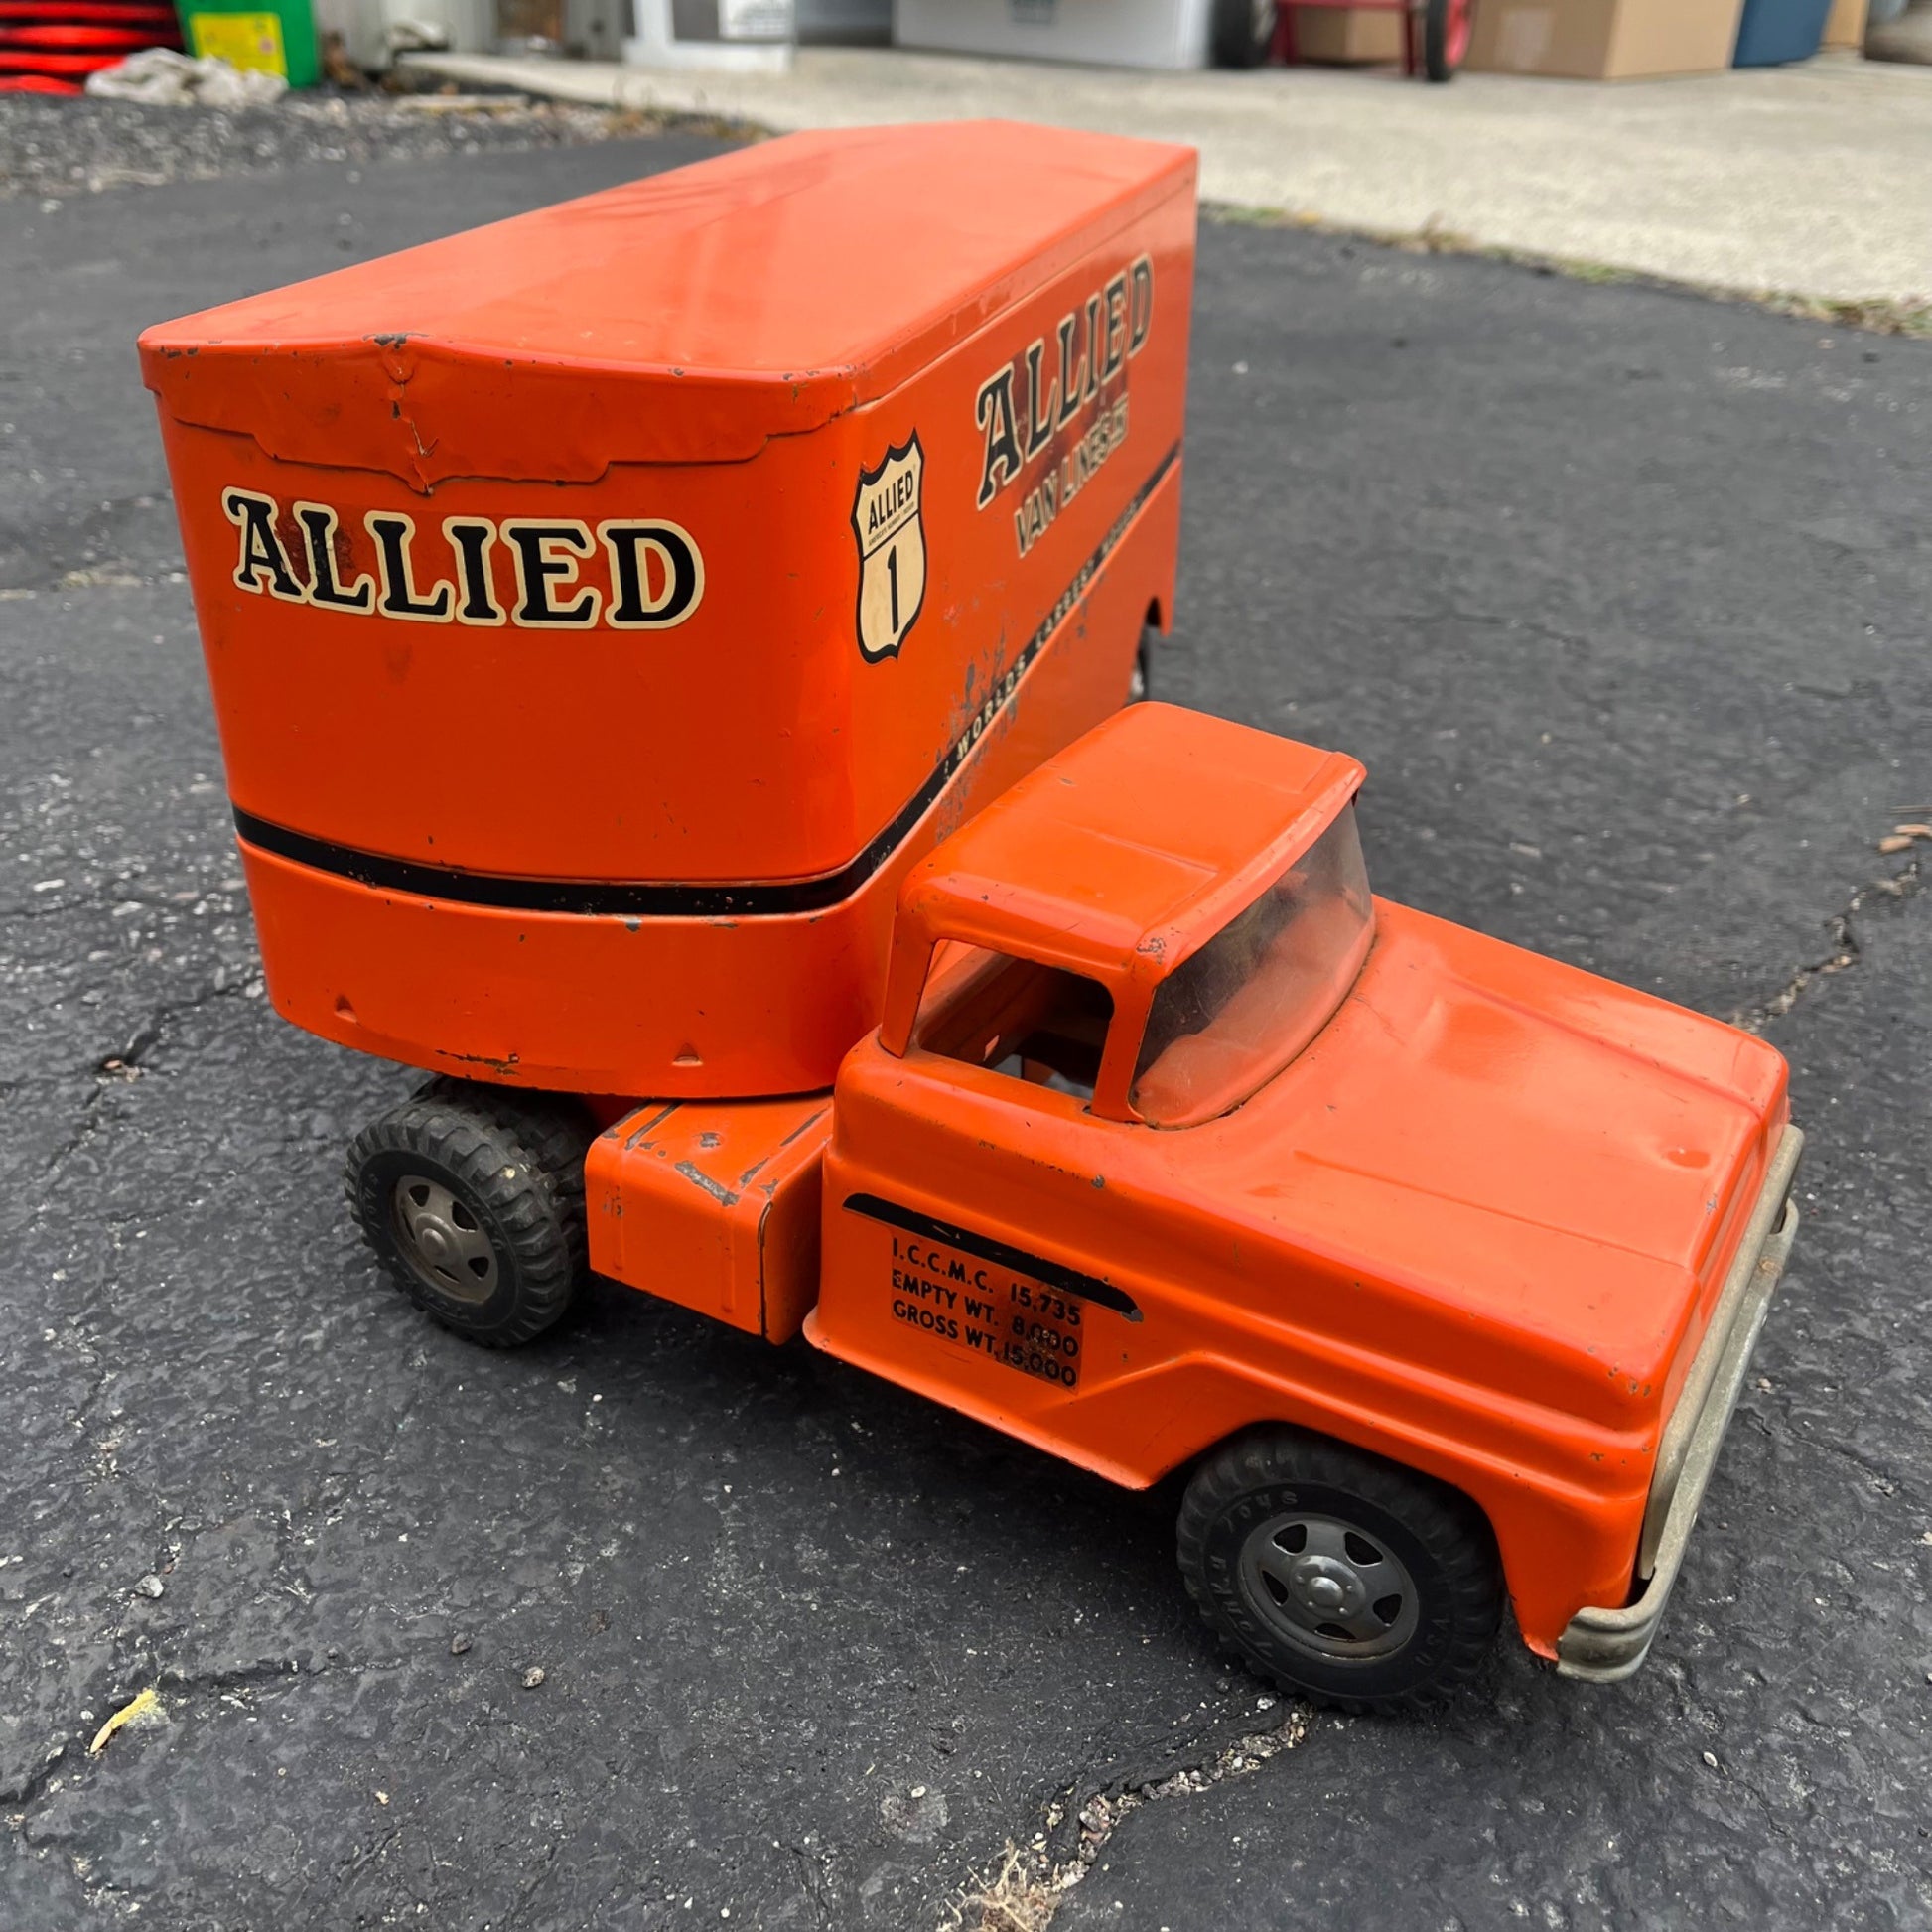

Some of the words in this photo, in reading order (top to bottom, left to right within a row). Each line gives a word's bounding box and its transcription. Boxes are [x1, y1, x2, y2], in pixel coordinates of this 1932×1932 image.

[975, 252, 1154, 511] ALLIED
[868, 469, 914, 535] ALLIED
[1013, 470, 1059, 559] VAN
[221, 485, 705, 629] ALLIED
[887, 544, 899, 635] 1
[892, 1268, 958, 1310] EMPTY
[964, 1296, 999, 1327] WT.
[893, 1299, 959, 1340] GROSS
[1011, 1283, 1081, 1326] 15,735
